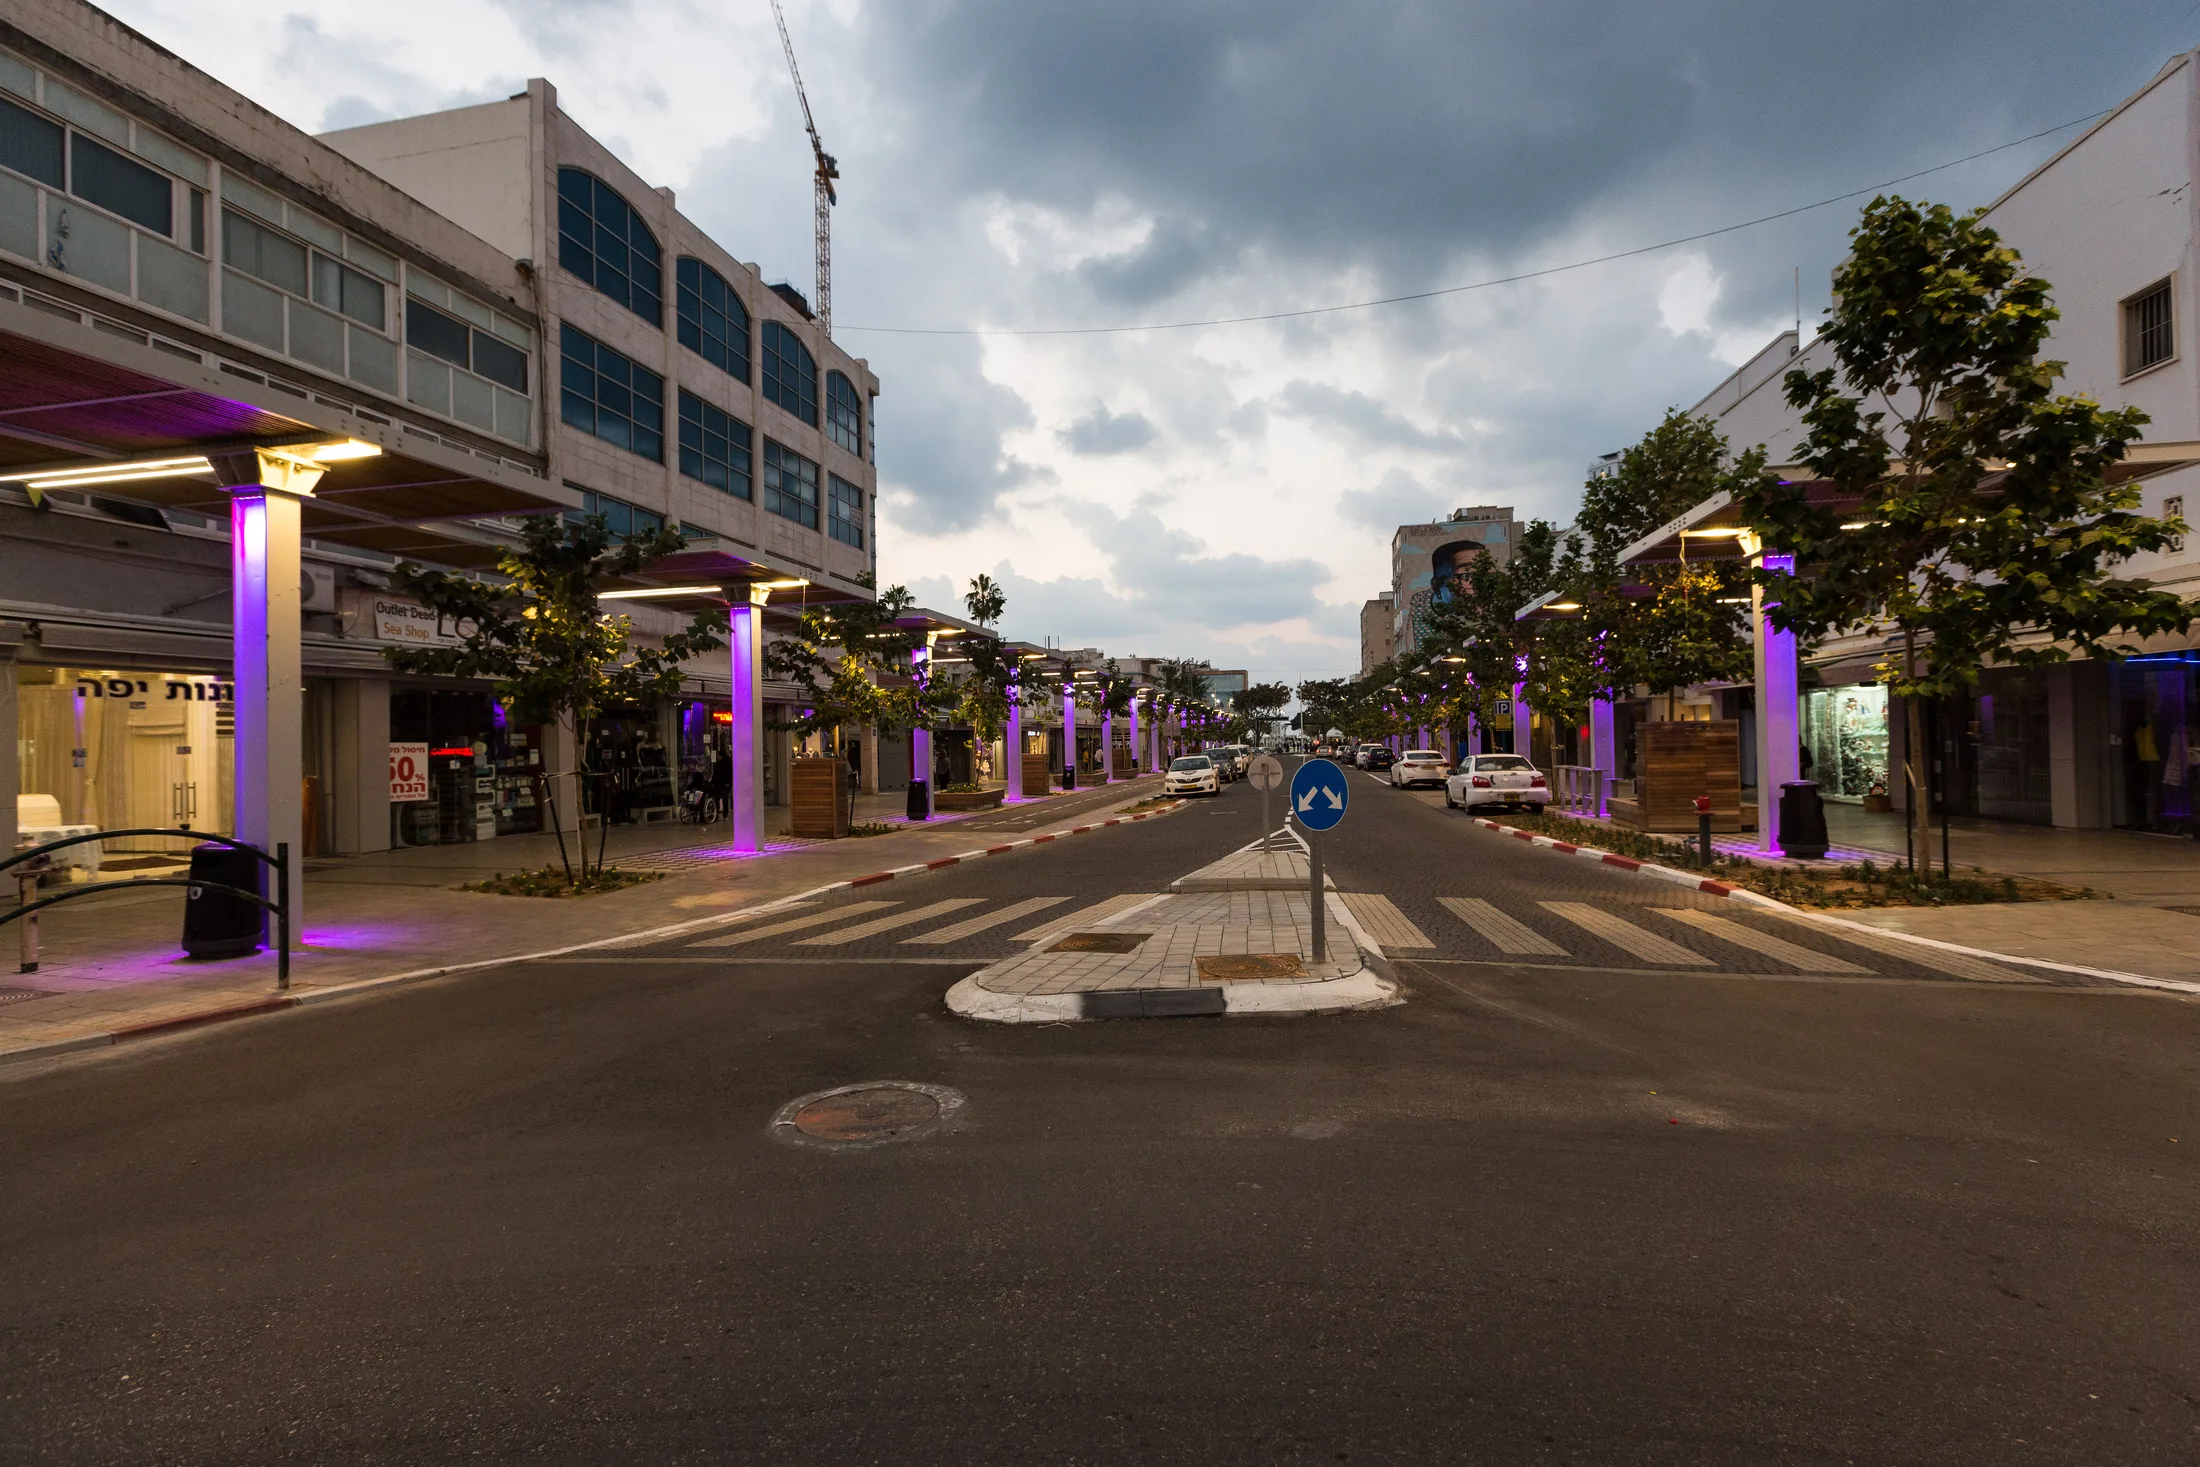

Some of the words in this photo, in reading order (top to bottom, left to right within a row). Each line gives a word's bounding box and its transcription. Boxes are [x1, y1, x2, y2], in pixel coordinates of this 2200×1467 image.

[376, 601, 407, 617] Outlet
[410, 606, 436, 621] Dead
[383, 622, 402, 635] Sea
[405, 624, 430, 641] Shop
[77, 678, 148, 698] יפה
[1500, 703, 1508, 714] P
